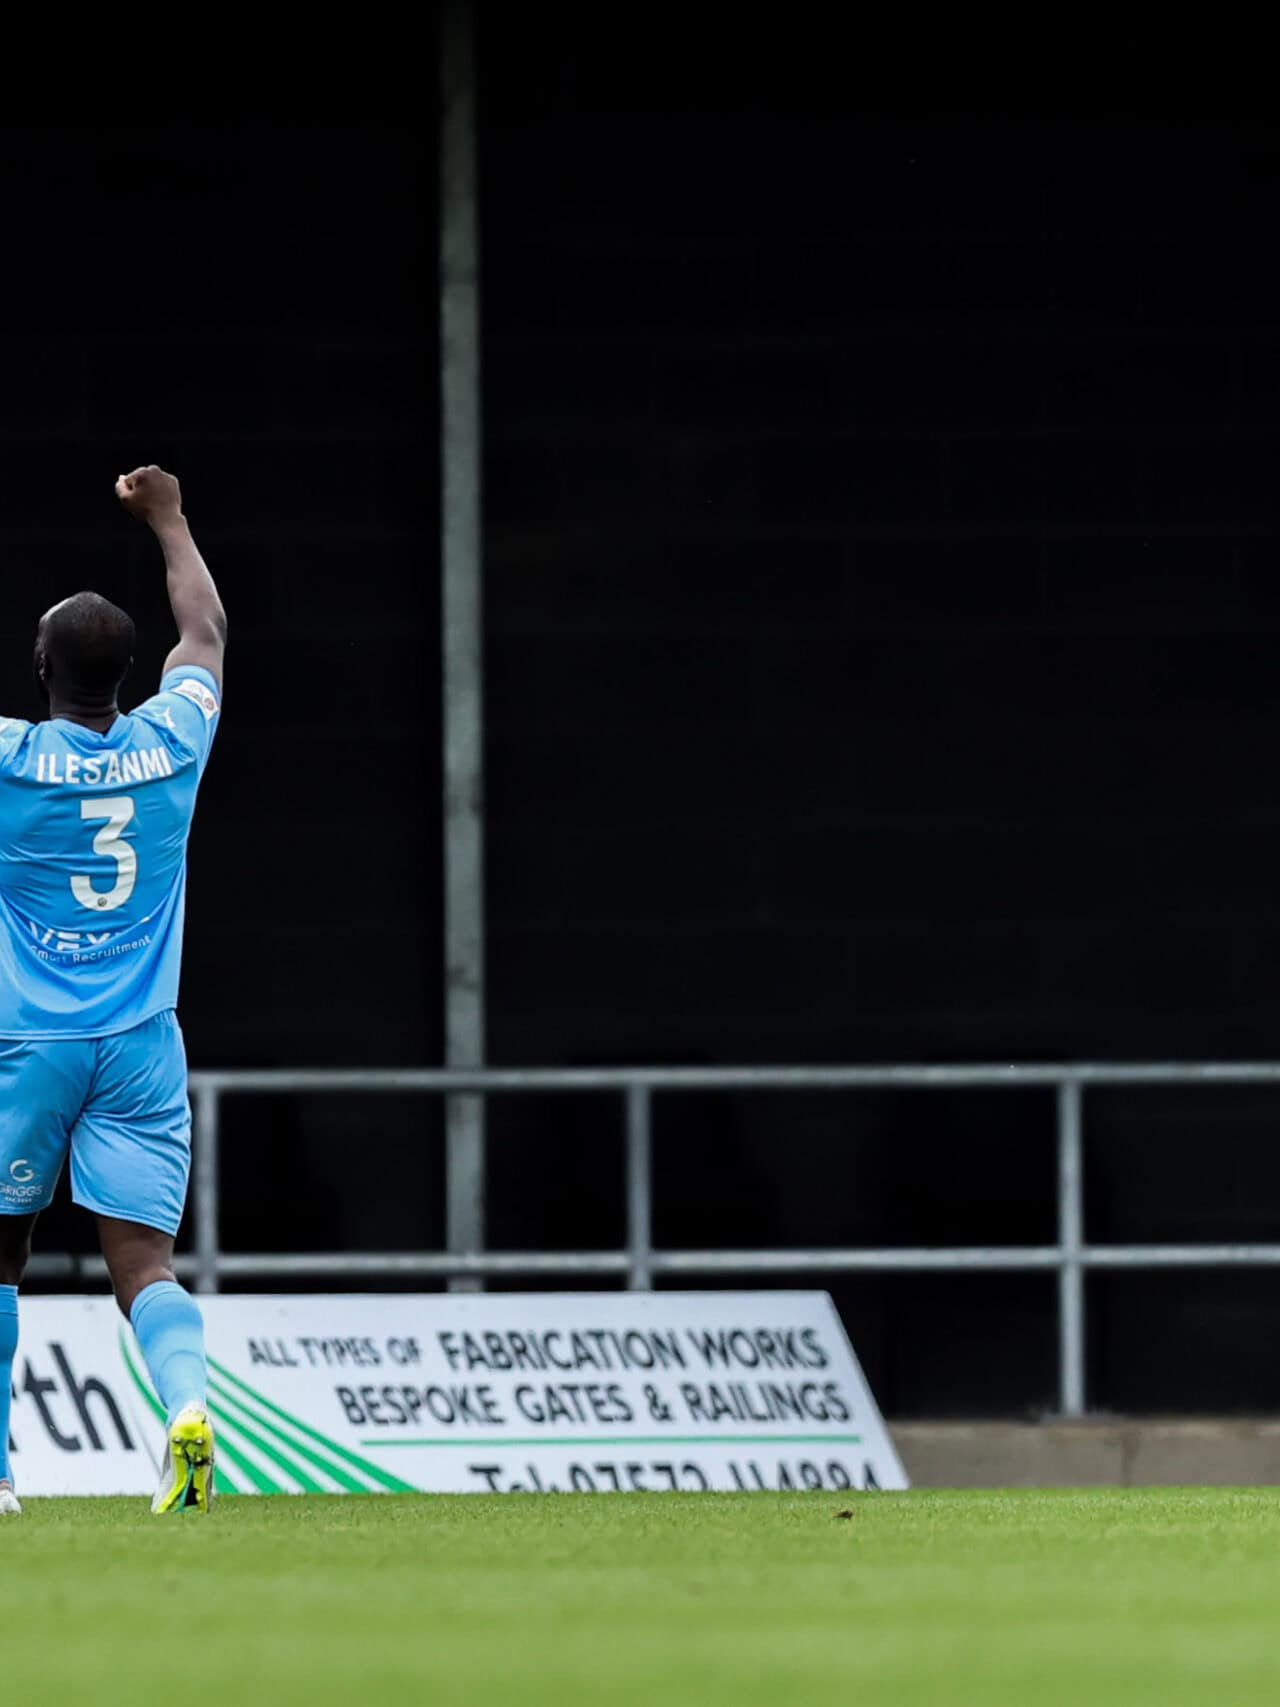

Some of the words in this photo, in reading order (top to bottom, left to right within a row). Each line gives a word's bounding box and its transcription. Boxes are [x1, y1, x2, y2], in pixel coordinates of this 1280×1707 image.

[35, 746, 174, 784] ILESANMI
[70, 796, 137, 912] 3
[72, 934, 153, 963] Recruitment
[247, 1336, 298, 1368] ALL
[297, 1336, 382, 1368] TYPES
[386, 1336, 421, 1366] OF
[437, 1330, 687, 1371] FABRICATION
[686, 1327, 829, 1370] WORKS
[335, 1385, 506, 1425] BESPOKE
[514, 1384, 634, 1424] GATES
[643, 1383, 672, 1422] &
[679, 1381, 851, 1422] RAILINGS
